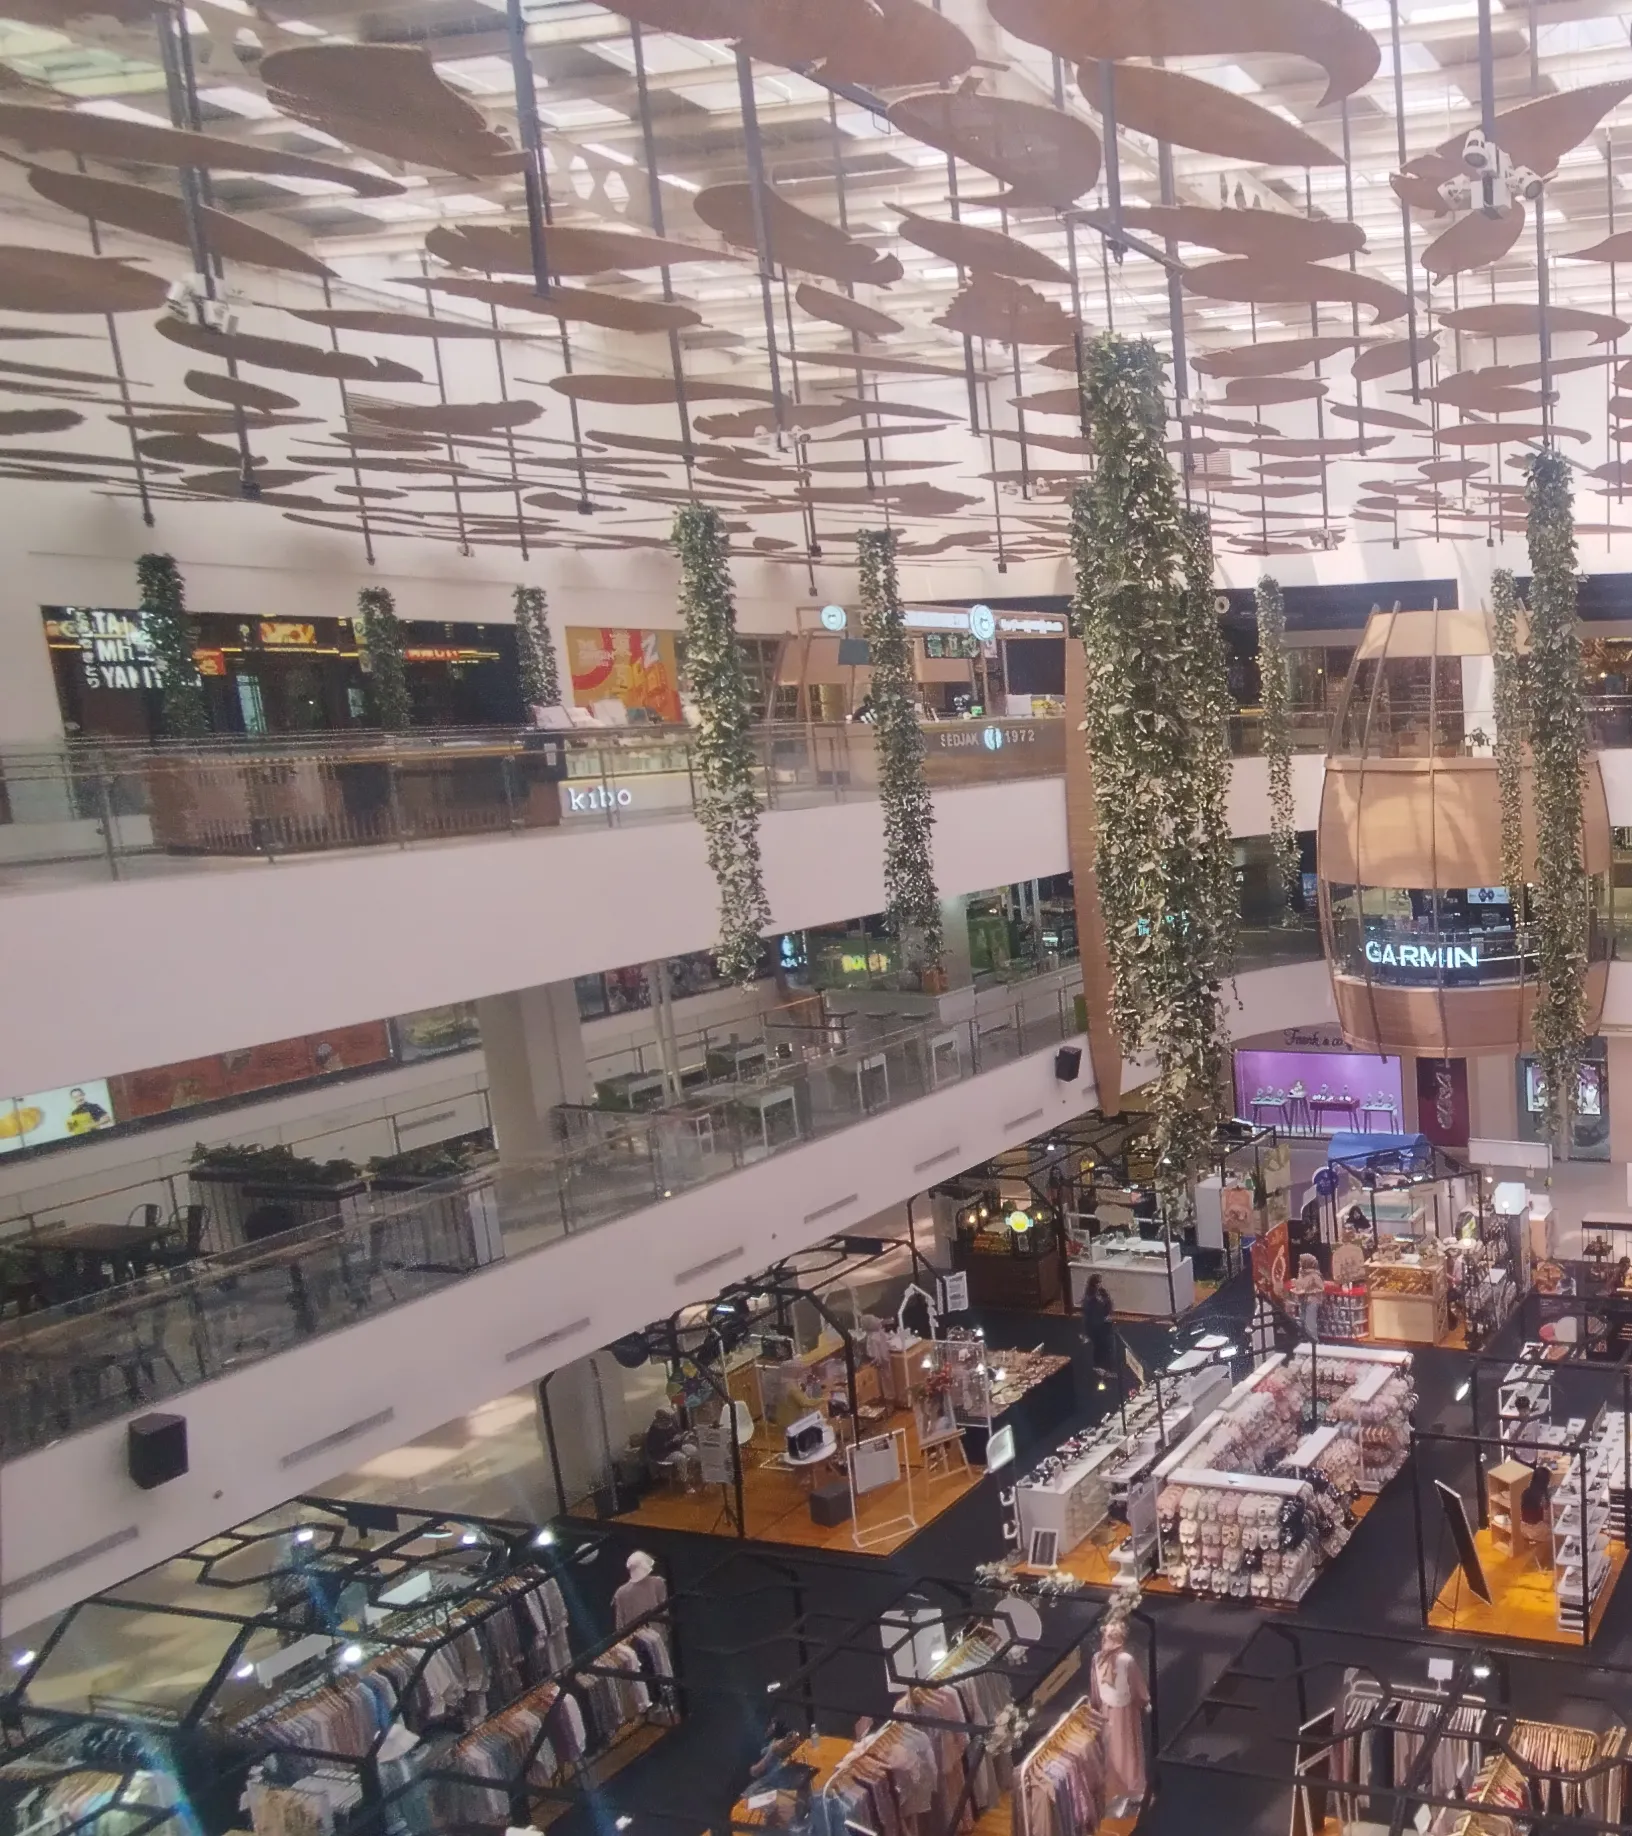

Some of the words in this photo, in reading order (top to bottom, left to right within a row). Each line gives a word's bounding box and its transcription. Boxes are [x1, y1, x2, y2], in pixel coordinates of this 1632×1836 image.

[1005, 729, 1036, 744] 1972
[567, 785, 632, 811] kibo
[1365, 940, 1478, 969] GARMIN
